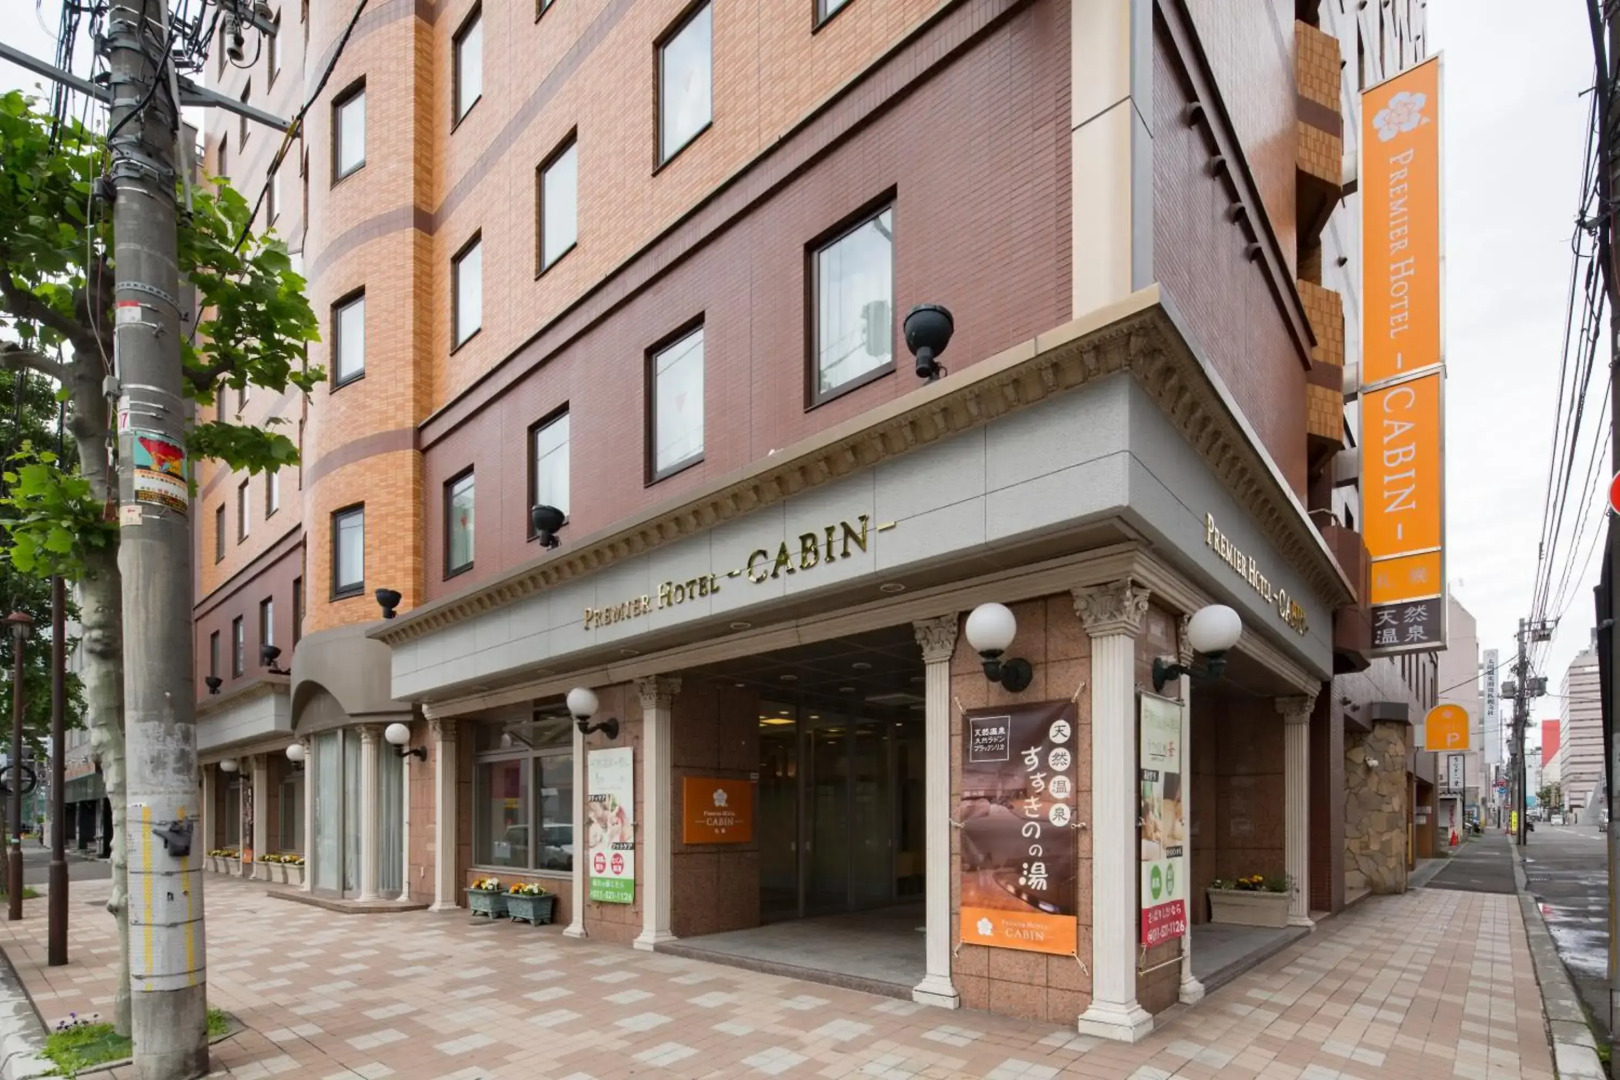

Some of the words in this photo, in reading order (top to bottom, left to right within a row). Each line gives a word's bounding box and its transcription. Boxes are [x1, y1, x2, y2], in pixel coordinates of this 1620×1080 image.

[1389, 148, 1414, 256] PREMIER
[1390, 256, 1415, 340] HOTEL
[584, 594, 653, 631] PREMIER
[656, 573, 721, 610] HOTEL
[1374, 604, 1429, 626] 天然
[1374, 624, 1430, 644] 温泉
[1446, 732, 1460, 747] P
[1051, 723, 1070, 824] 天然温泉
